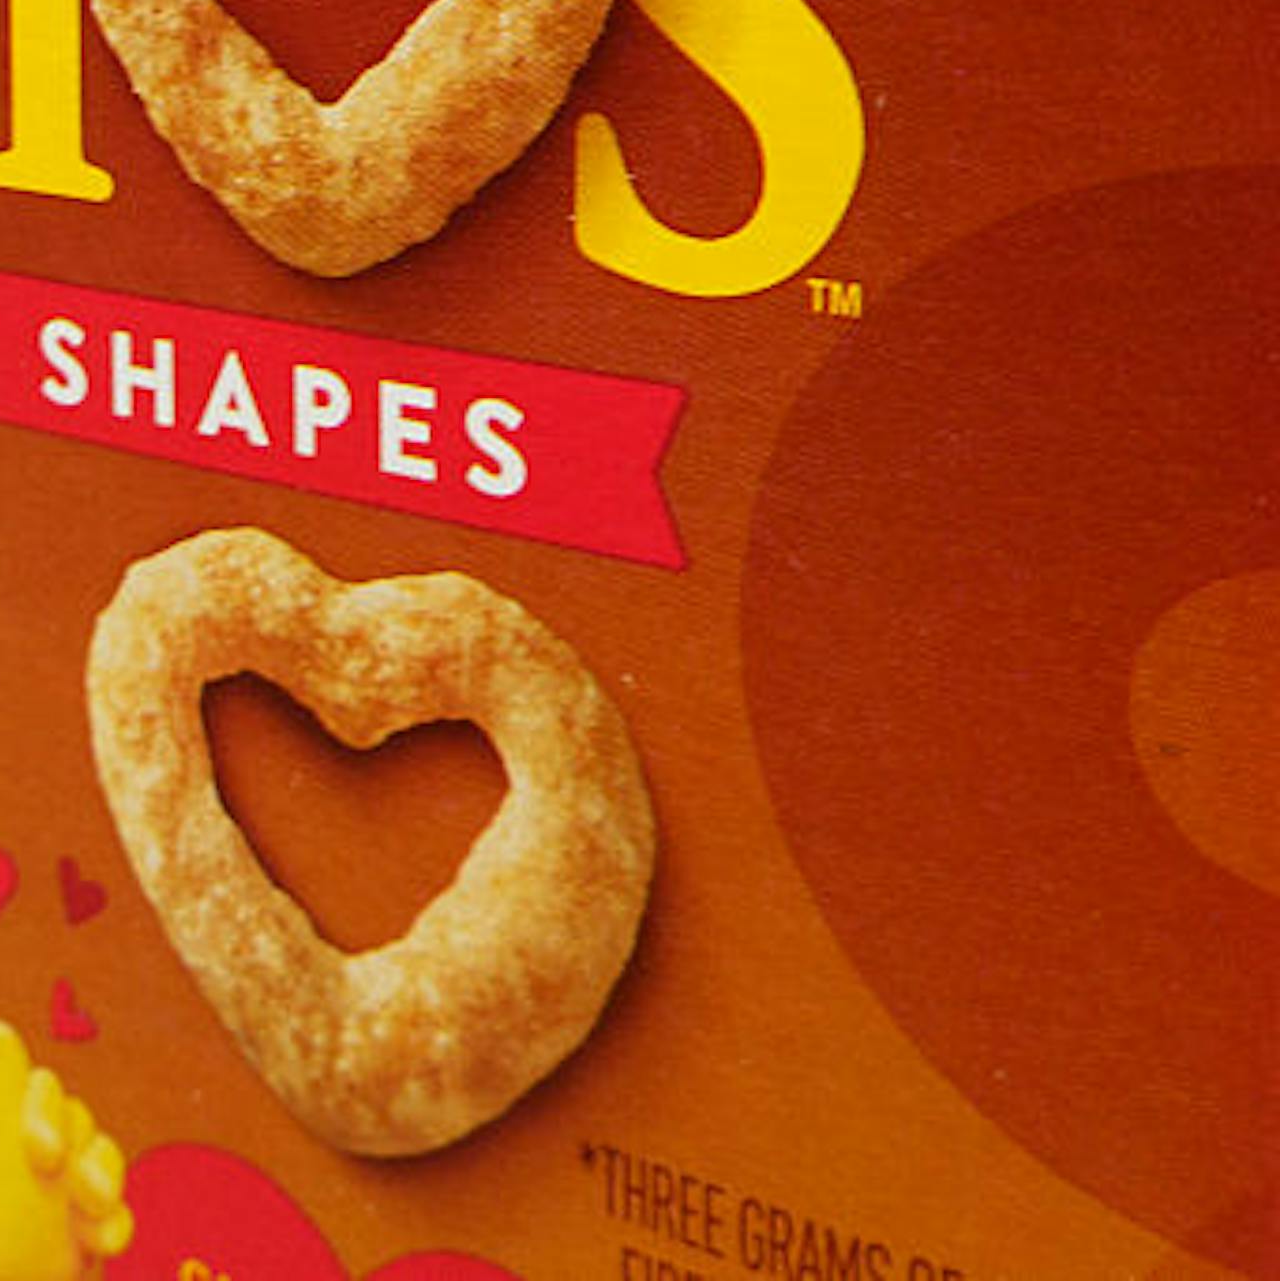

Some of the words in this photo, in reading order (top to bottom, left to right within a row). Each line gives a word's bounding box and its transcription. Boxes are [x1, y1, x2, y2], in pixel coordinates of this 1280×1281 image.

[807, 275, 864, 320] TM
[38, 317, 530, 500] SHAPES
[739, 1195, 894, 1281] GRAMS
